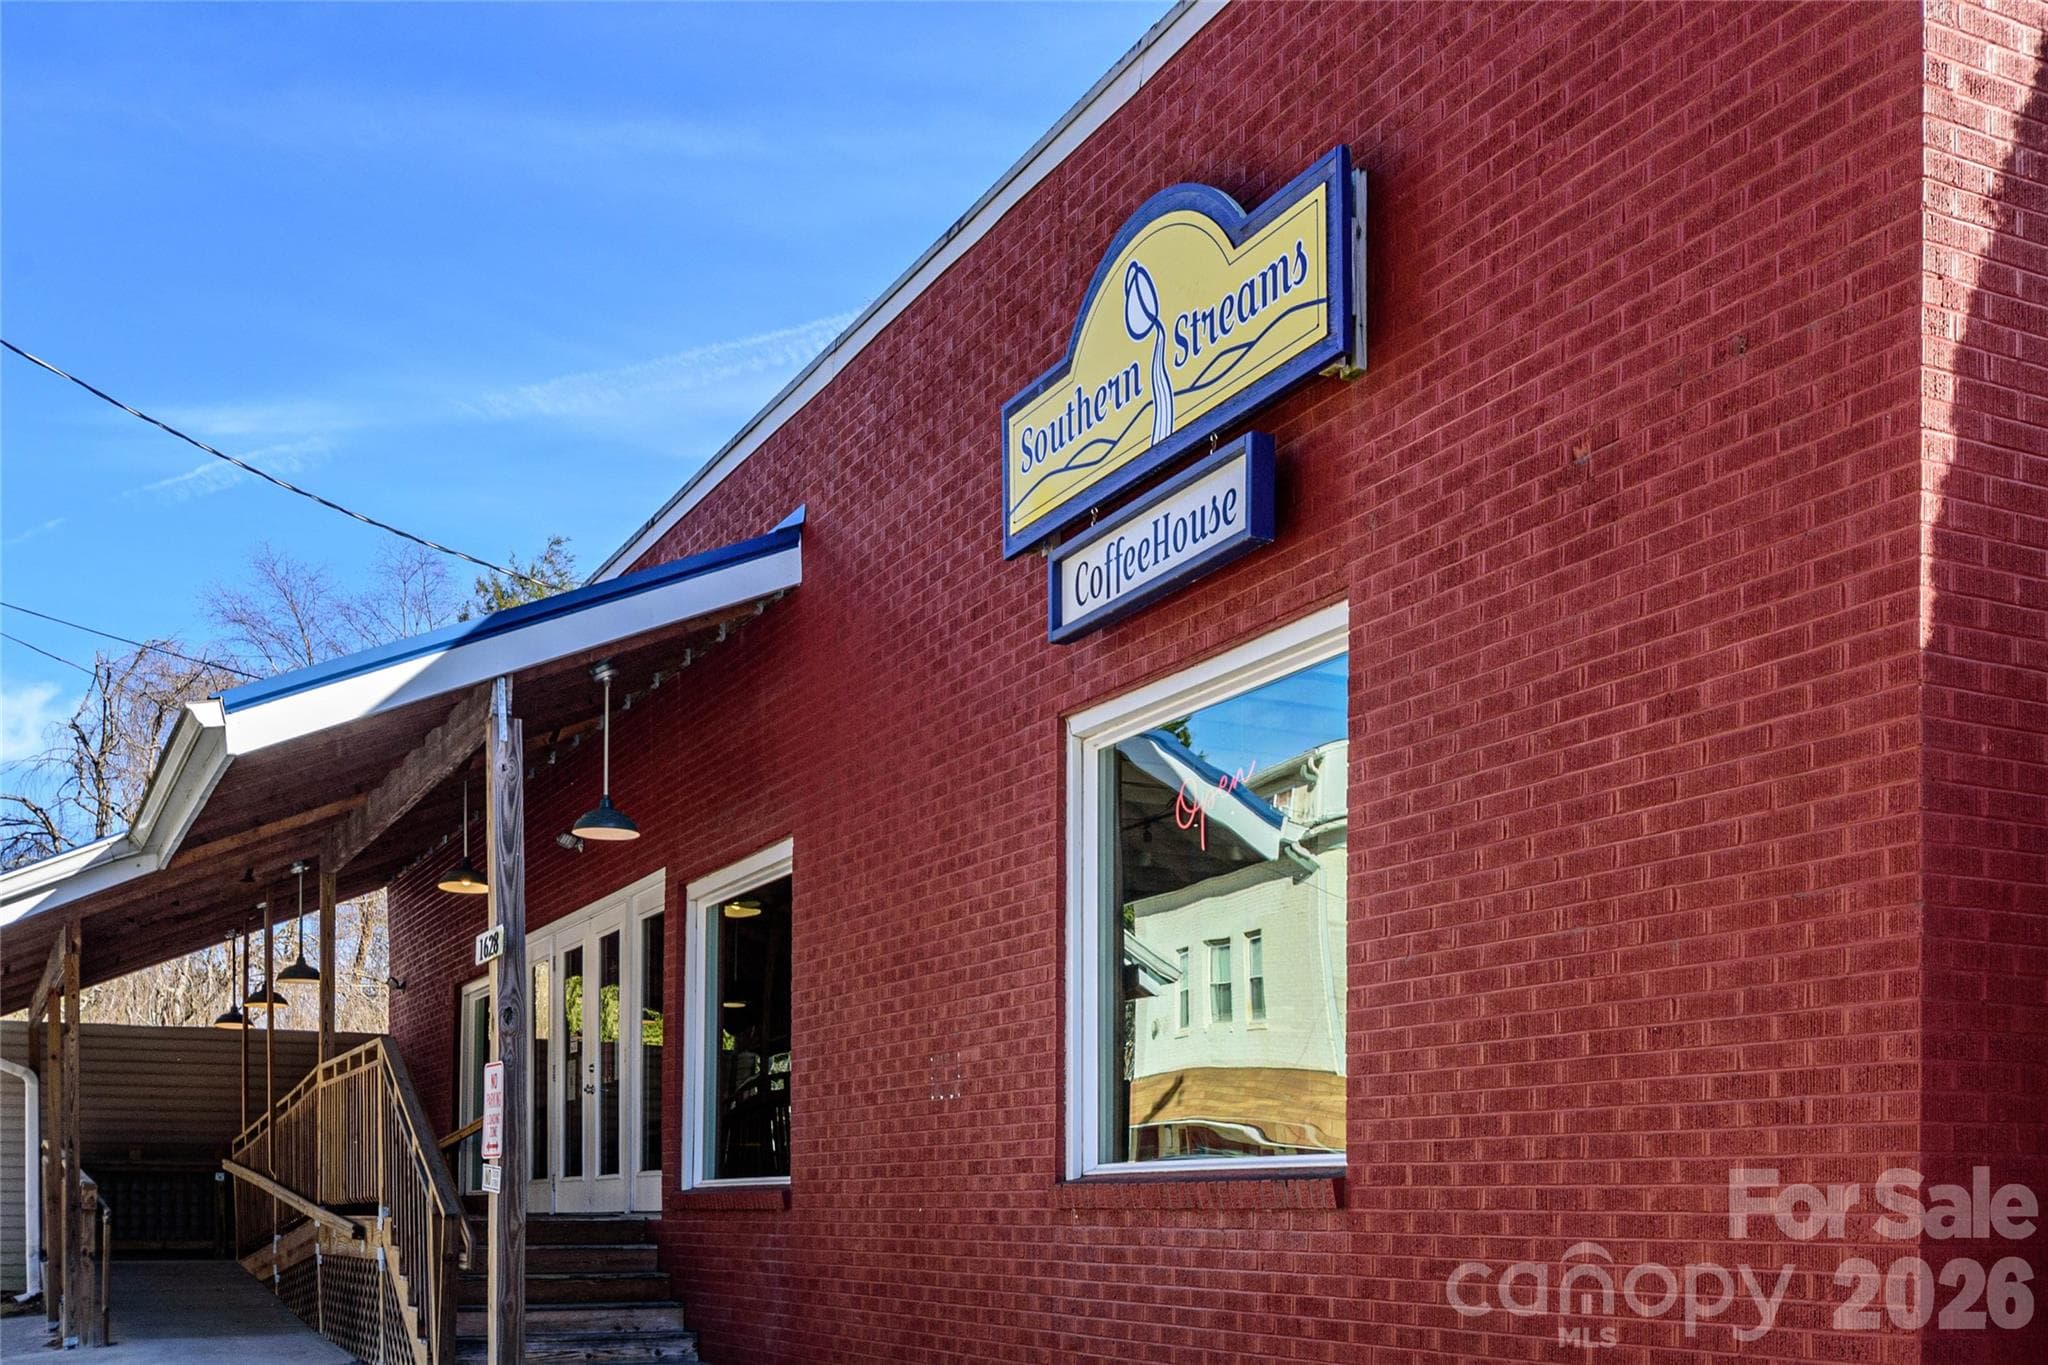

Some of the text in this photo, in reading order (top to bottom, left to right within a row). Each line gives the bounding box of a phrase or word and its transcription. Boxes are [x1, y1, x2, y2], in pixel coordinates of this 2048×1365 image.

[1021, 240, 1307, 472] Southern Streams
[1074, 486, 1238, 606] CoffeeHouse
[1175, 760, 1256, 851] Open
[479, 931, 499, 960] 1628
